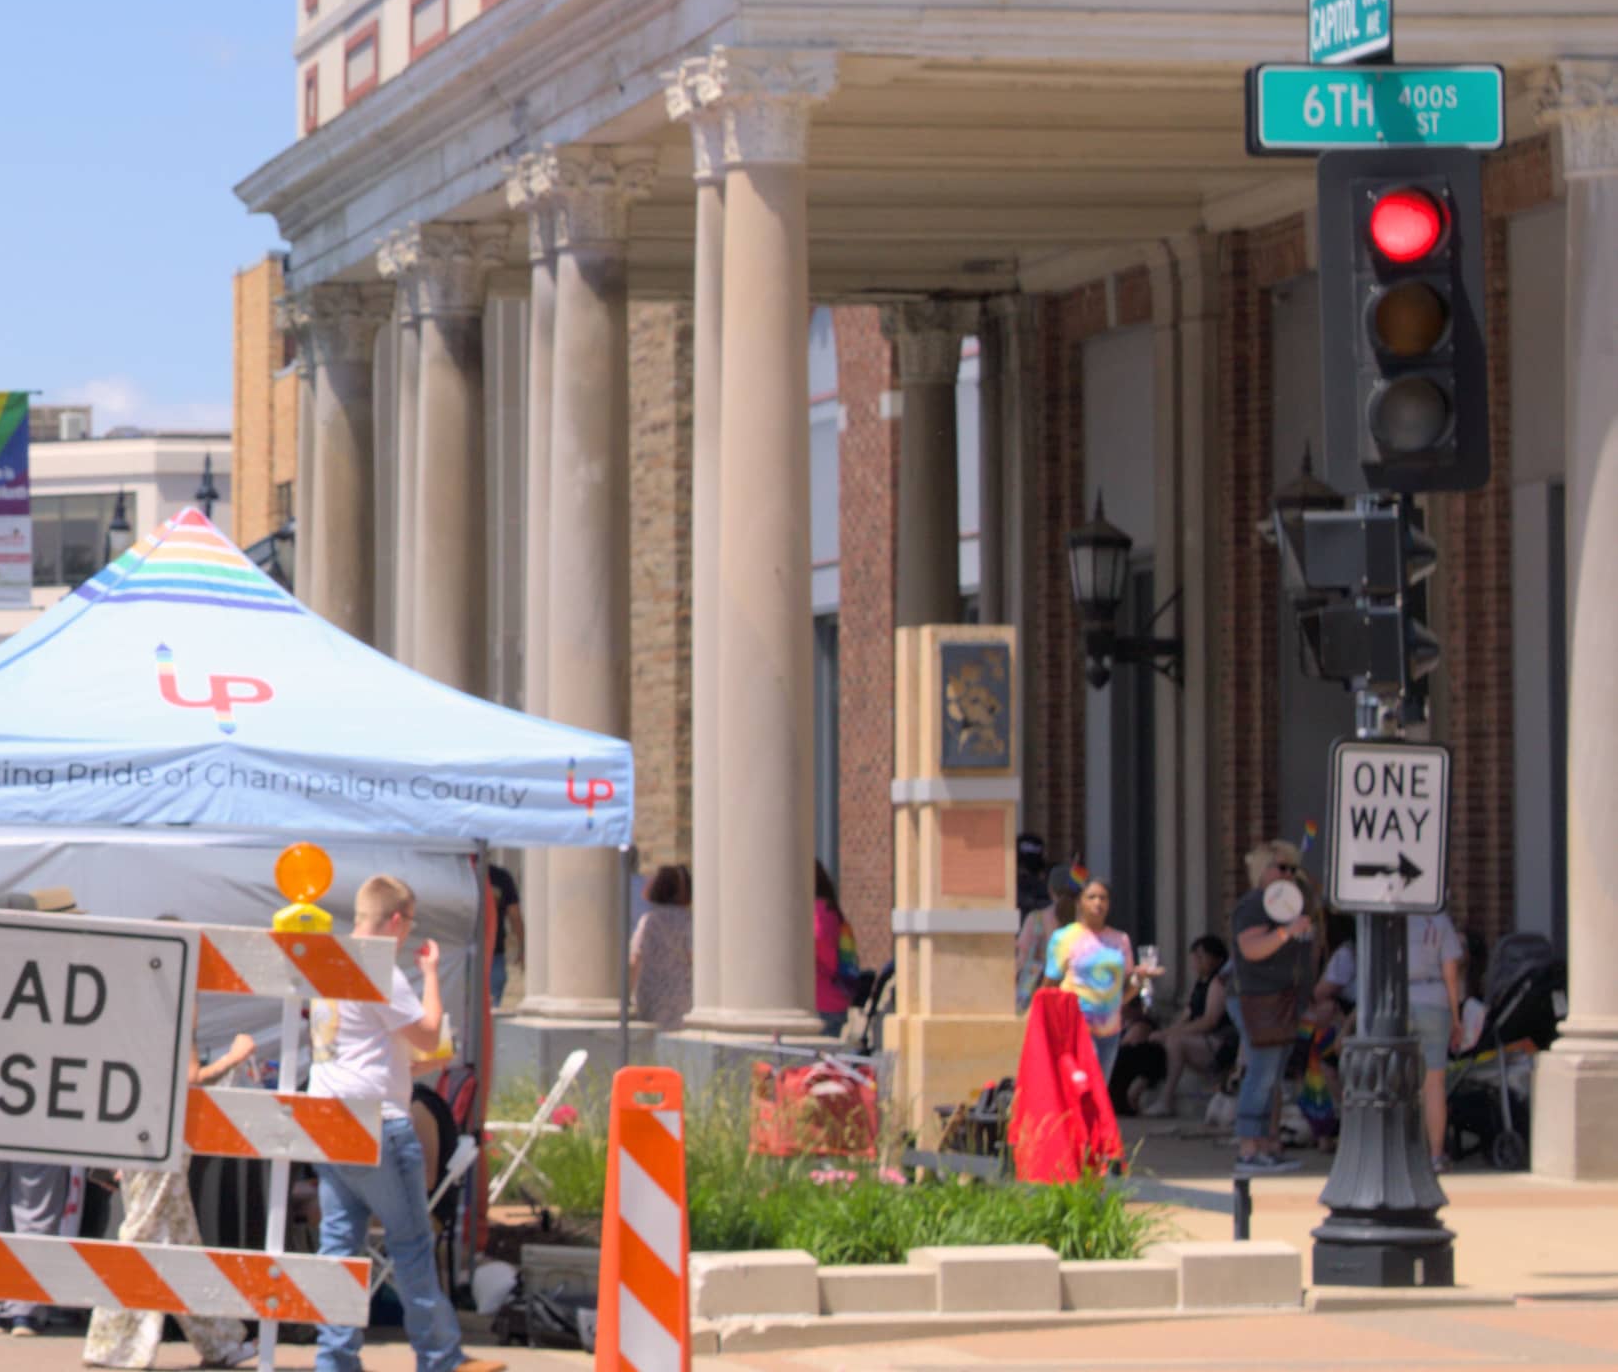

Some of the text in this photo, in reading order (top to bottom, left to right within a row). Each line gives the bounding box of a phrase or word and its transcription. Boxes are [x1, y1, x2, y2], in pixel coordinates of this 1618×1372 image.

[1366, 10, 1381, 36] AVE
[1303, 83, 1375, 127] 6TH
[1416, 112, 1441, 135] ST
[66, 758, 153, 787] Pride
[164, 759, 198, 787] of
[204, 761, 399, 802] Champaign
[408, 775, 529, 809] County
[1353, 761, 1430, 798] ONE
[1350, 805, 1430, 842] WAY
